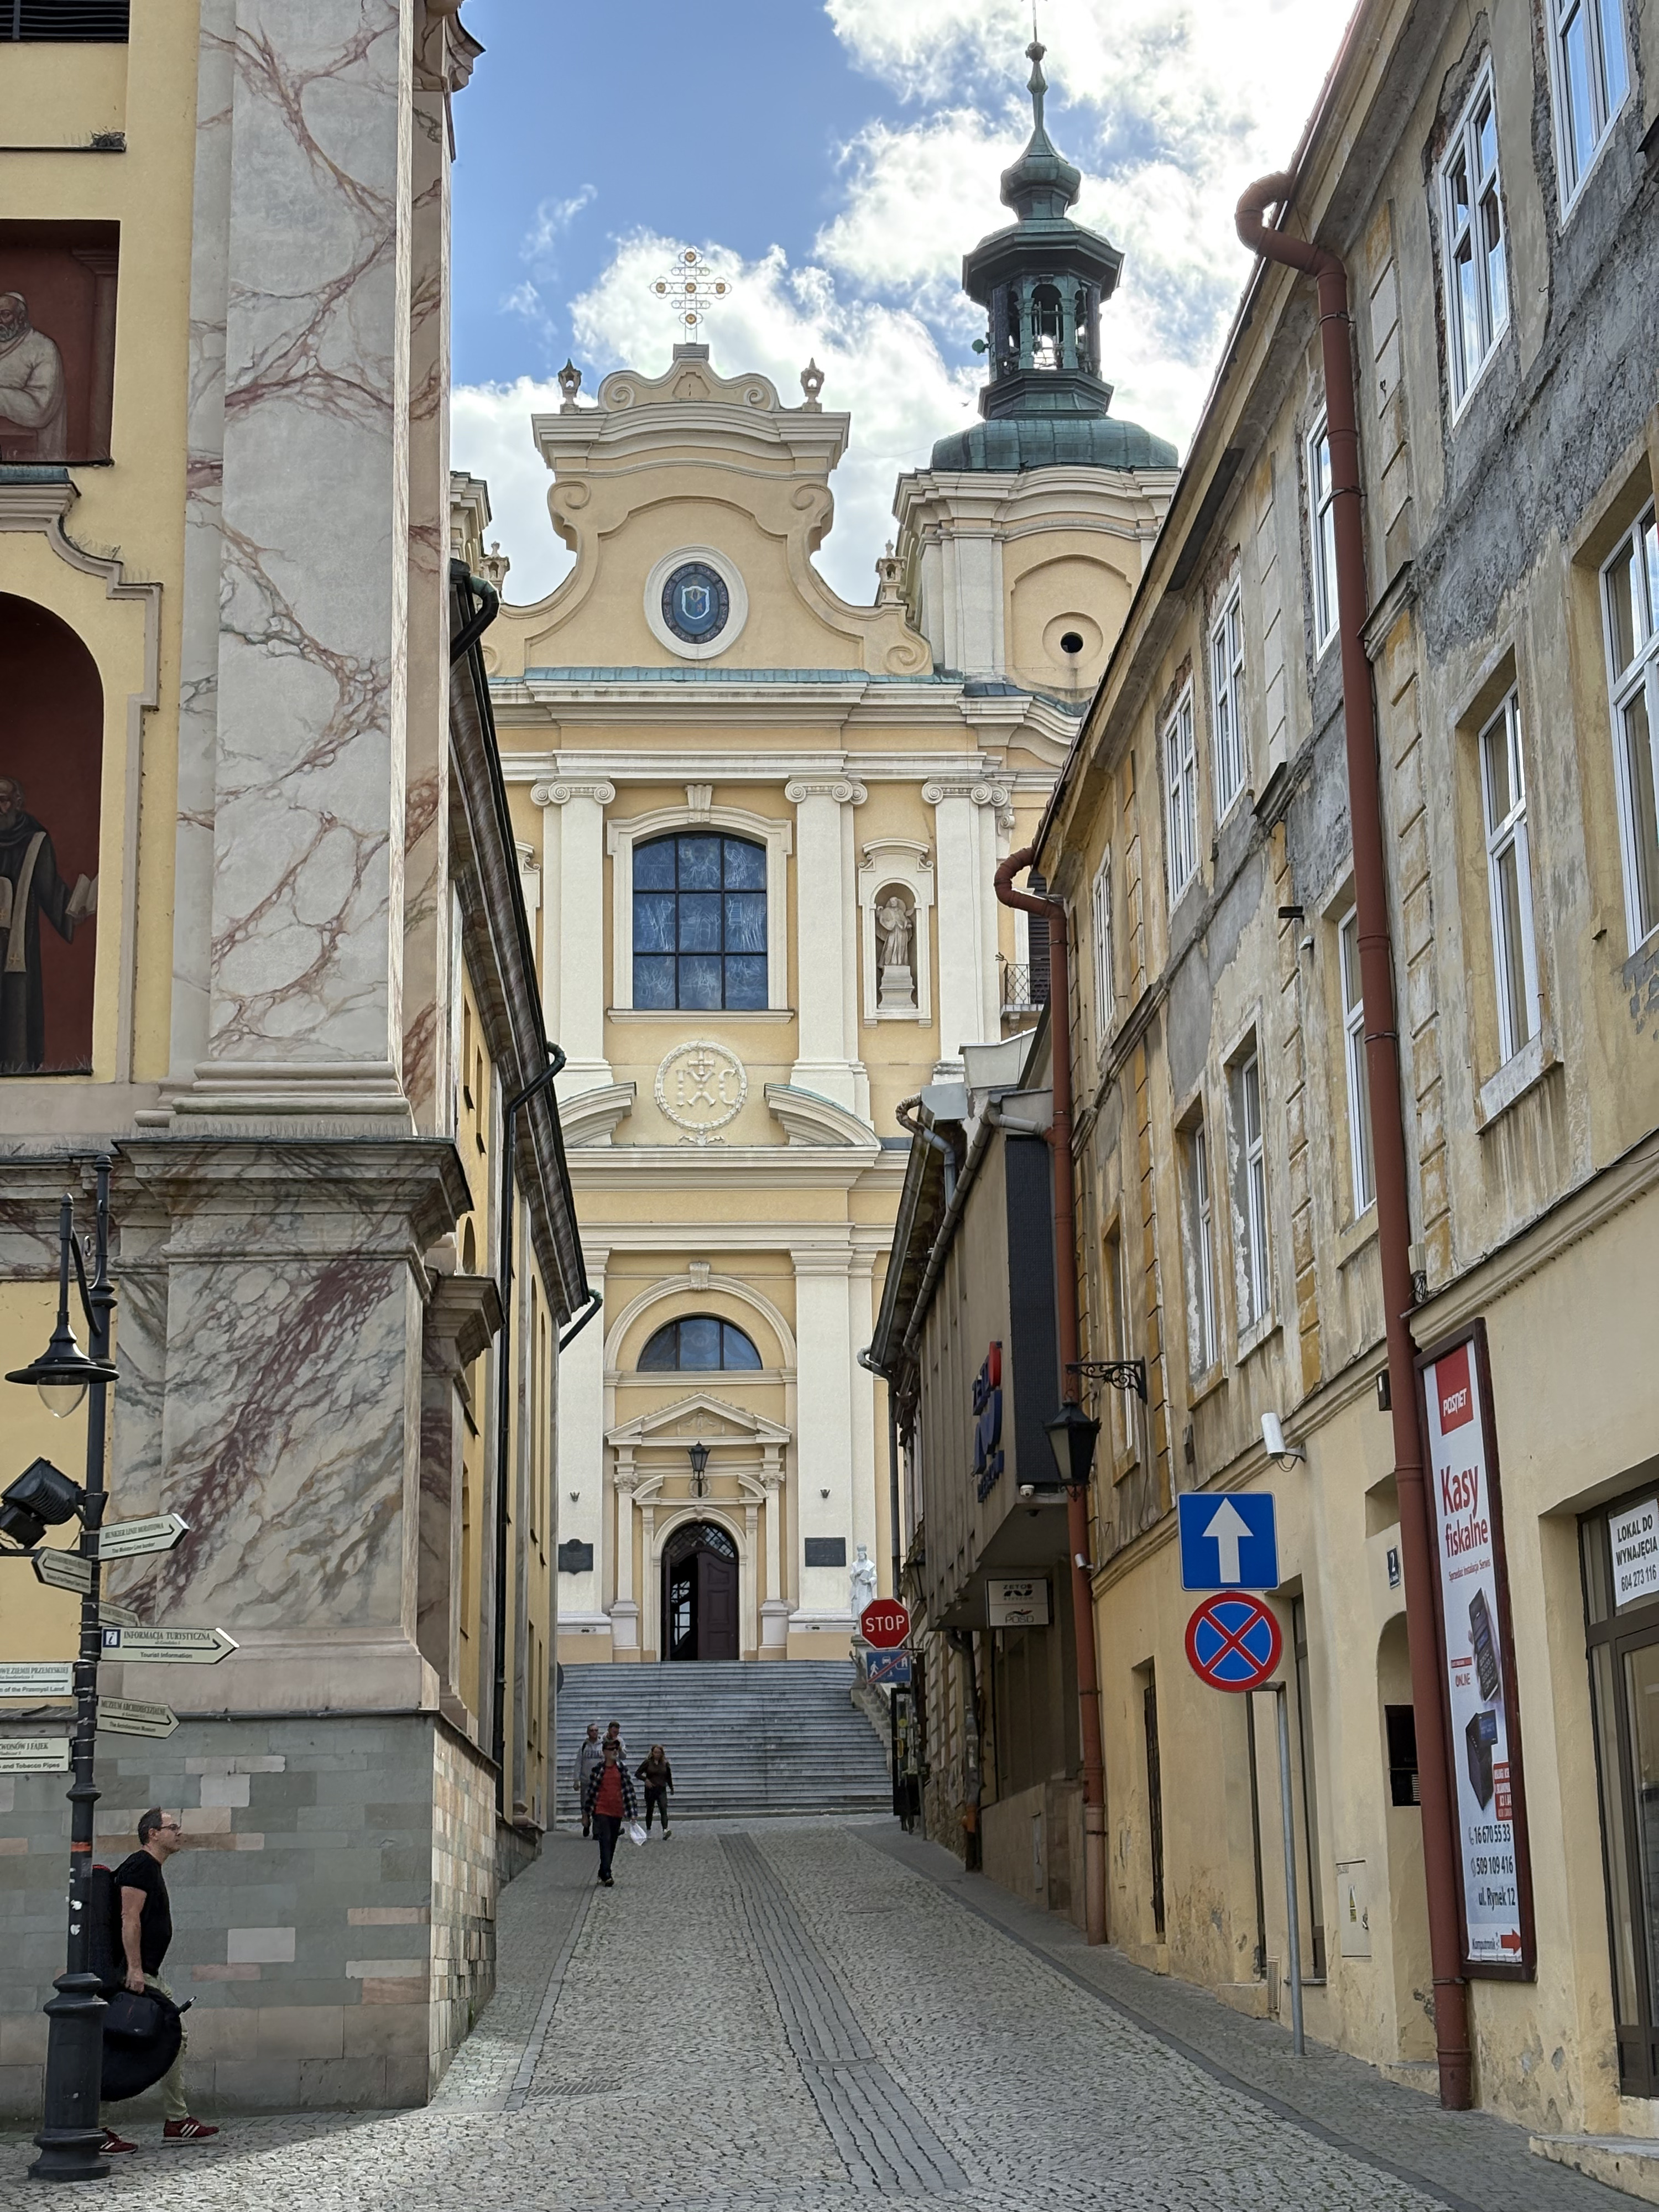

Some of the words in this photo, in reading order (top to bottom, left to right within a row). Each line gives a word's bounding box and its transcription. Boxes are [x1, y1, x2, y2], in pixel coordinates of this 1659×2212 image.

[1443, 1387, 1467, 1417] POSNET
[1440, 1465, 1478, 1520] Kasy
[1445, 1513, 1489, 1558] fiskalne
[1617, 1520, 1641, 1543] LOKAL
[1642, 1514, 1653, 1533] DO
[1390, 1552, 1396, 1573] 2
[1616, 1536, 1658, 1567] WYNAJĘCIA
[1621, 1575, 1632, 1592] 604
[1633, 1568, 1645, 1588] 273
[1645, 1564, 1657, 1584] 116
[123, 1631, 163, 1641] INFORMACJA
[166, 1632, 210, 1641] TURYSTYCZNA
[865, 1615, 905, 1632] STOP
[30, 1742, 49, 1751] FAJEK
[1474, 1826, 1482, 1844] 16
[1482, 1825, 1494, 1844] 670
[1494, 1824, 1503, 1843] 55
[1503, 1823, 1511, 1843] 33
[1476, 1856, 1488, 1875] 509
[1488, 1855, 1500, 1875] 109
[1501, 1855, 1514, 1874] 416
[1478, 1886, 1486, 1906] ul.
[1486, 1886, 1507, 1912] Rynek
[1507, 1887, 1516, 1906] 12
